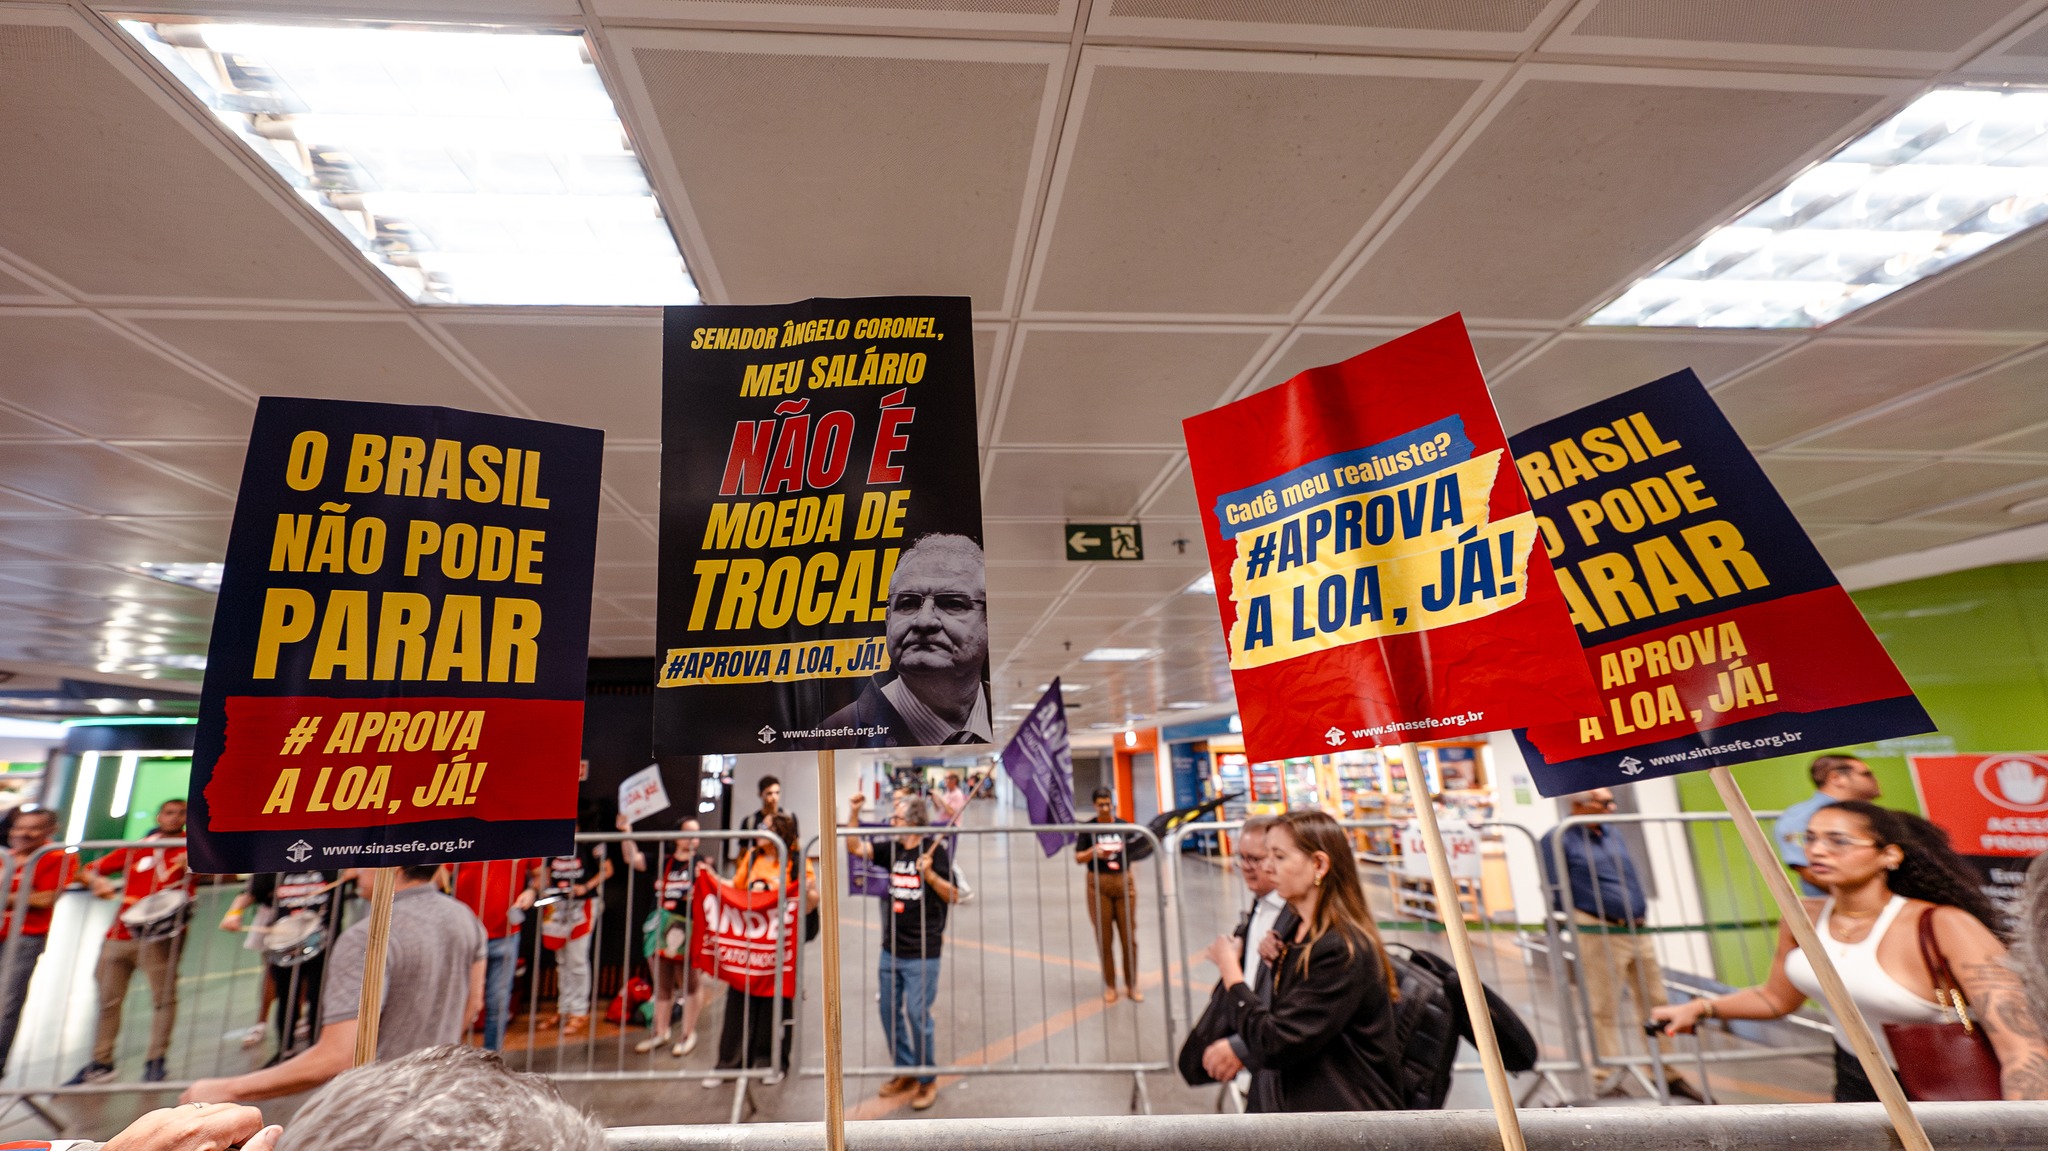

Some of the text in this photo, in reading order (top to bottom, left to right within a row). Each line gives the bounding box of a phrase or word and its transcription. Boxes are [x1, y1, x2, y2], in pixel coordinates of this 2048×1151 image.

[690, 317, 944, 350] SENADOR ÂNGELO CORONEL,
[740, 346, 927, 398] MEU SALÁRIO
[286, 431, 550, 510] O BRASIL
[719, 388, 917, 497] NÃO É
[1226, 431, 1452, 527] Cadê meu reajuste?
[1515, 412, 1682, 500] RASIL
[269, 502, 546, 585] NÃO PODE
[701, 490, 912, 551] MOEDA DE
[1246, 472, 1465, 582] #APROVA
[1567, 464, 1719, 547] PODE
[687, 547, 901, 632] TROCA!
[1243, 594, 1274, 652] A
[1420, 525, 1517, 613] JÁ!
[1554, 520, 1771, 634] ARAR
[252, 588, 542, 683] PARAR
[666, 648, 770, 679] #APROVA
[775, 650, 790, 675] A
[846, 637, 884, 672] JÁ!
[1600, 621, 1749, 691] APROVA
[280, 710, 486, 756] # APROVA
[782, 723, 890, 741] www.sinasefe.org.br
[1351, 710, 1485, 741] www.sinasefe.org.br
[1579, 716, 1604, 744] A
[1706, 661, 1779, 714] JÁ!
[262, 752, 488, 815] A LOA, JÁ!
[1649, 729, 1803, 768] www.sinasefe.org.br
[322, 837, 475, 857] www.sinasefe.org.br
